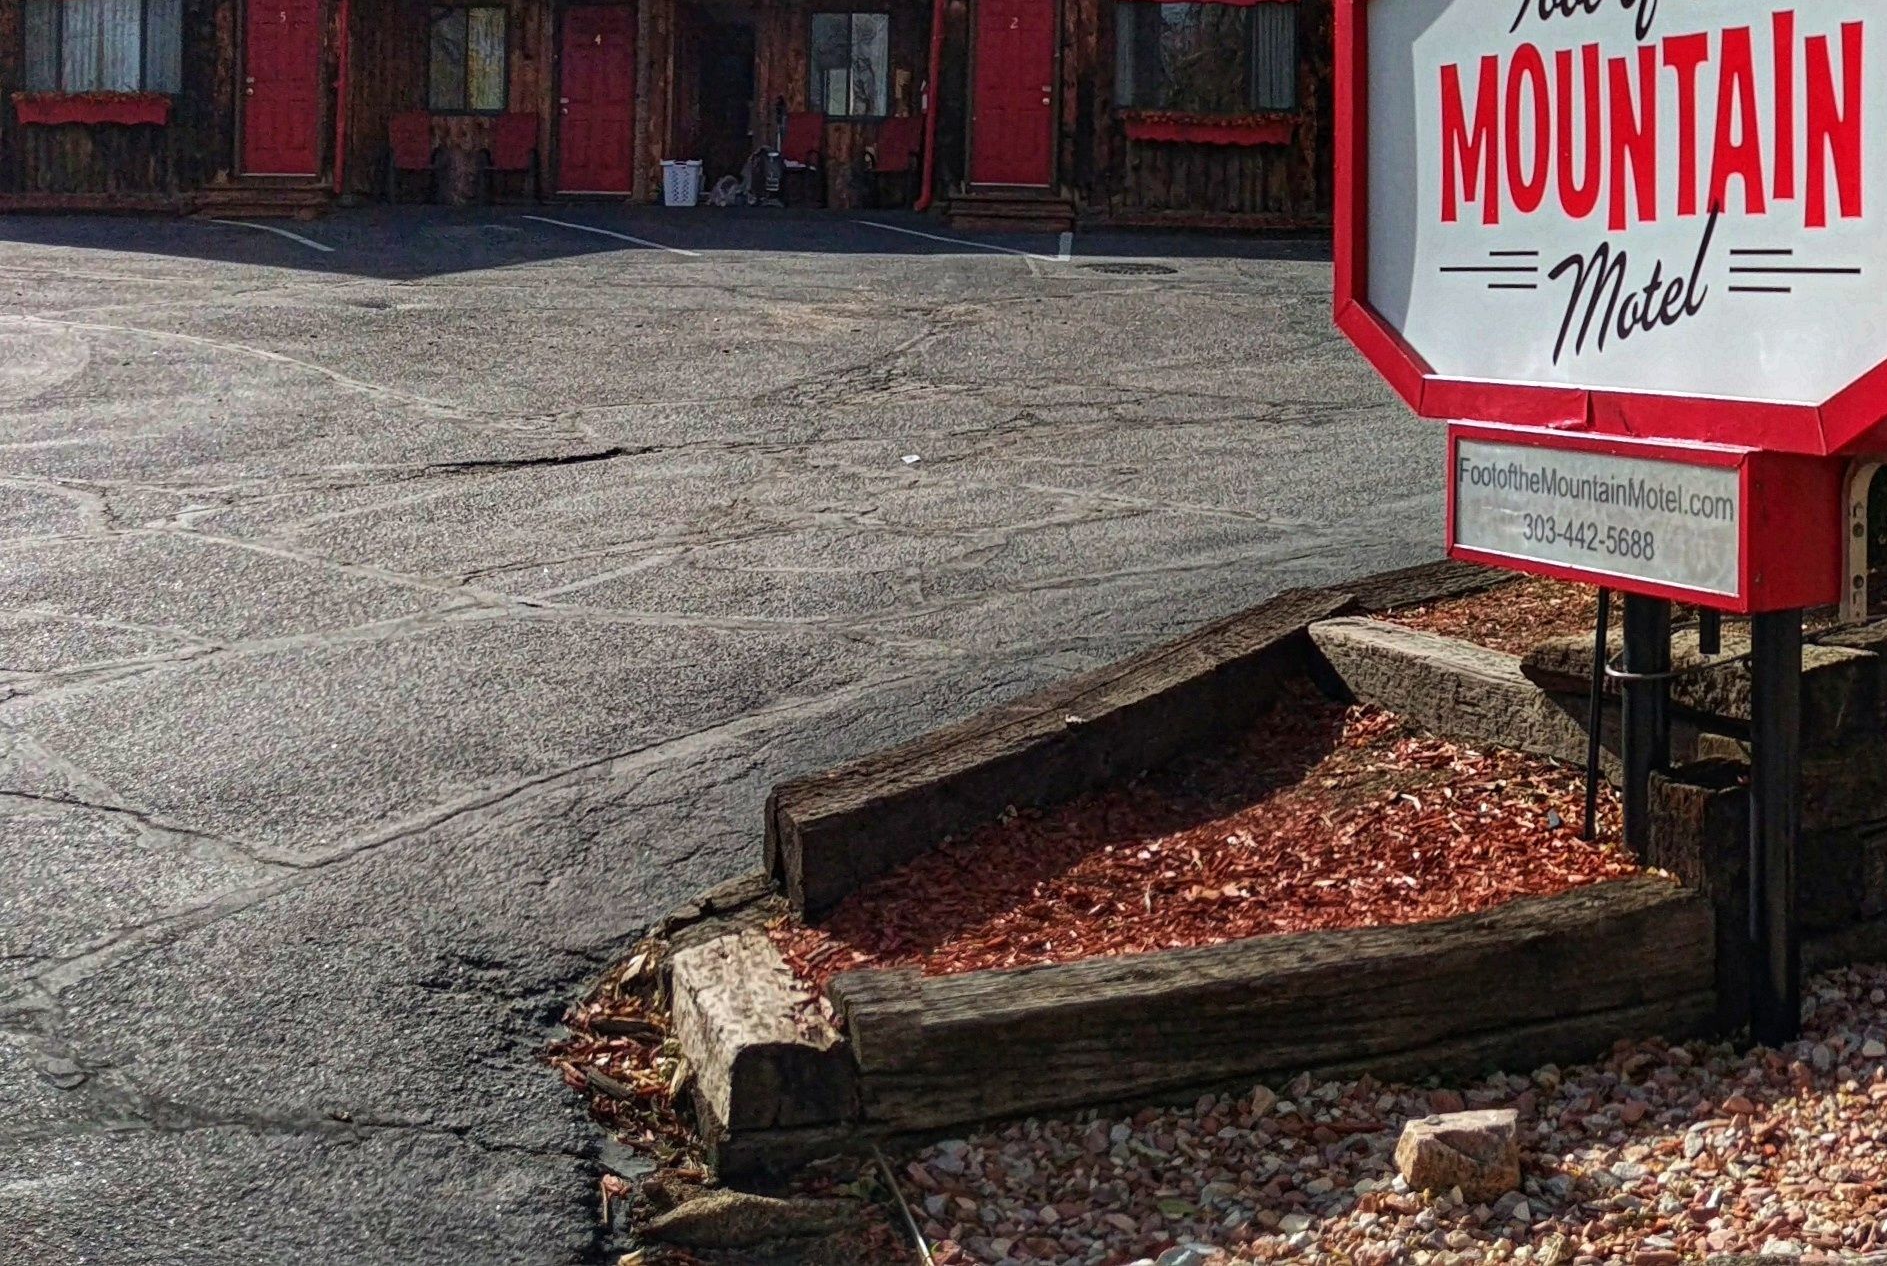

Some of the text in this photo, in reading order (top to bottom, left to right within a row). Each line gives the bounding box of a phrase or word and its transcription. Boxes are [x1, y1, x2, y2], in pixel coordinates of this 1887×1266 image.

[280, 11, 286, 23] 5
[1440, 10, 1863, 230] MOUNTAIN
[1548, 201, 1720, 366] Motel
[1459, 457, 1734, 521] FootoftheMountainMotel.com
[1523, 513, 1655, 561] 303-442-5688
